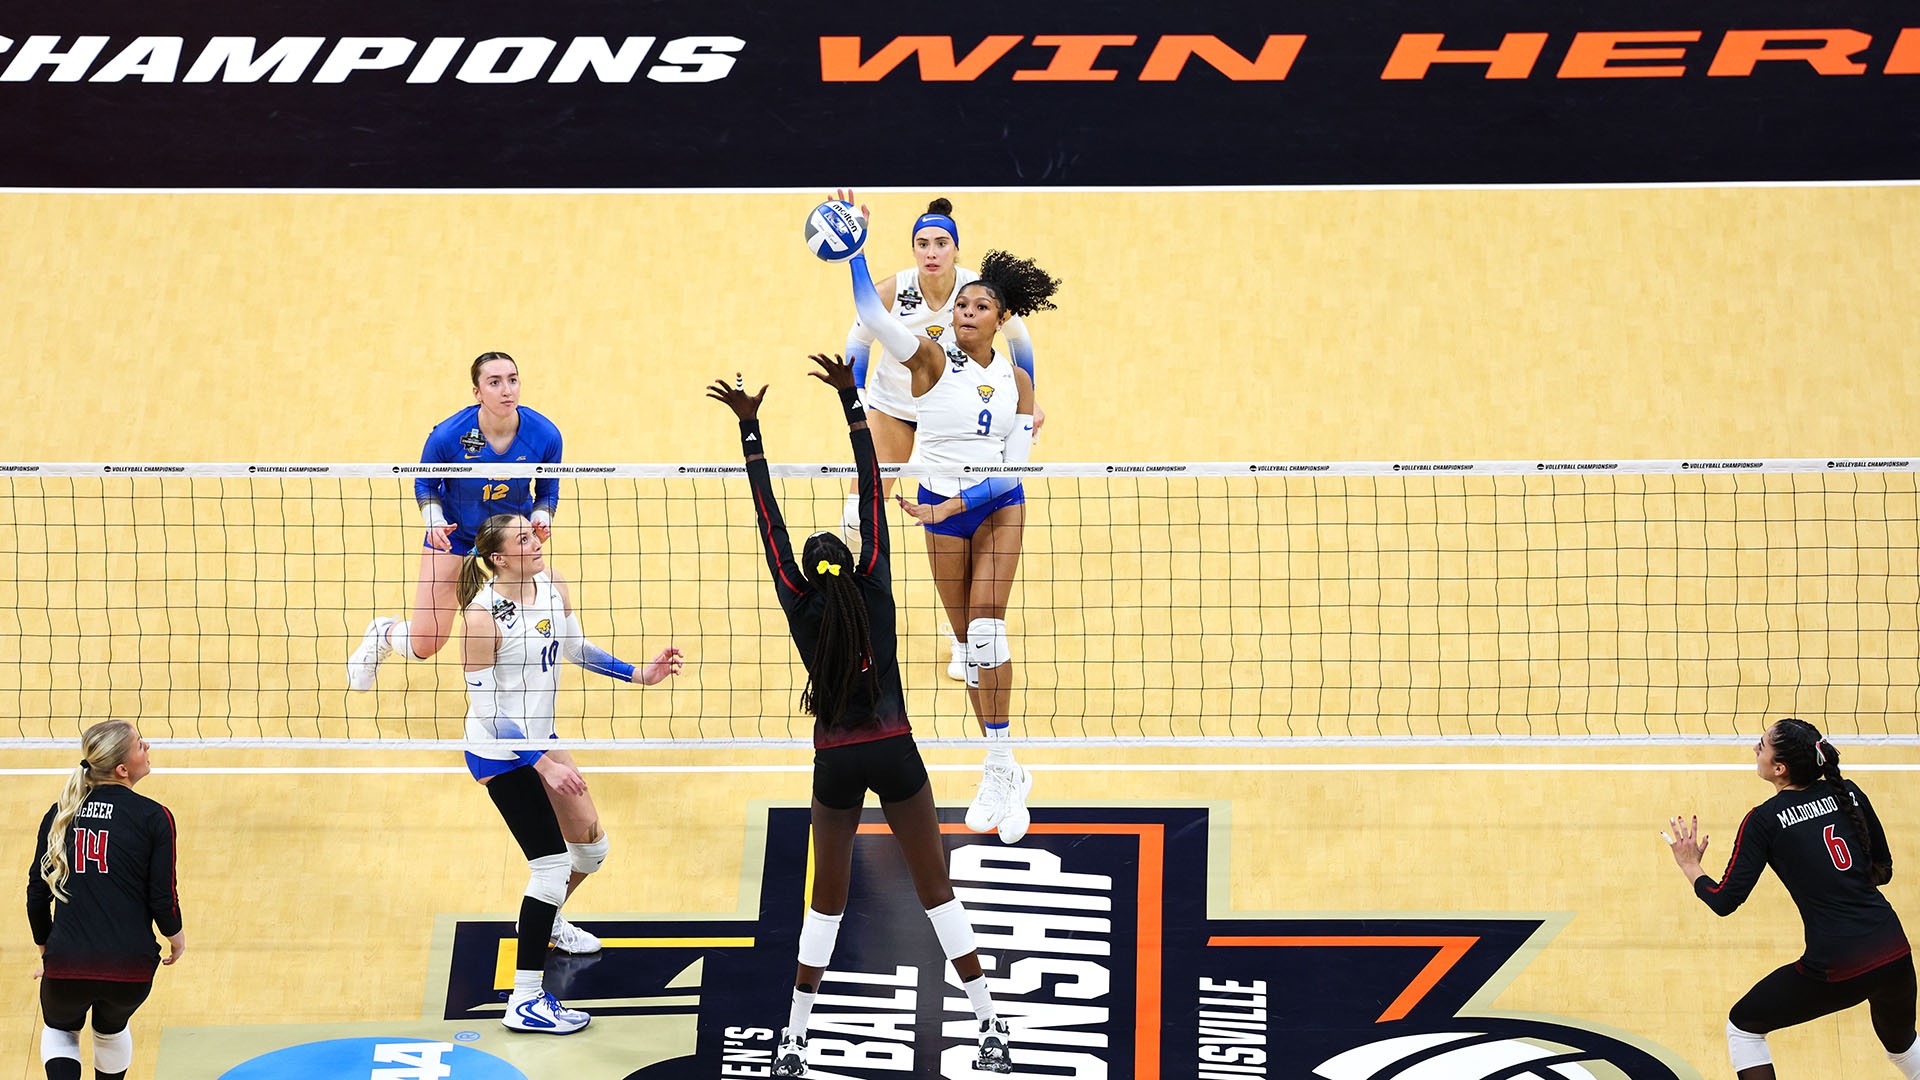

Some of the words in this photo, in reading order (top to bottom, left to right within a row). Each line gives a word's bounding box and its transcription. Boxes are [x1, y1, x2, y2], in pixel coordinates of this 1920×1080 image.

[0, 34, 747, 84] HAMPIONS
[819, 33, 1306, 82] WIN
[1380, 27, 1920, 80] HER
[977, 408, 993, 436] 9
[112, 465, 143, 473] VOLLEYBALL
[143, 465, 185, 473] CHAMPIONSHIP
[256, 465, 287, 473] VOLLEYBALL
[288, 465, 330, 473] CHAMPIONSHIP
[400, 465, 431, 473] VOLLEYBALL
[431, 465, 473, 473] CHAMPIONSHIP
[972, 465, 1002, 473] VOLLEYBALL
[1003, 465, 1044, 473] CHAMPIONSHIP
[1257, 464, 1288, 472] VOLLEYBALL
[1289, 464, 1330, 472] CHAMPIONSHIP
[1835, 461, 1866, 469] VOLLEYBALL
[1867, 461, 1910, 469] CHAMPIONSHIP
[482, 483, 510, 502] 12
[540, 640, 560, 673] 10
[1776, 795, 1838, 829] MALDONADO
[73, 827, 109, 873] 14
[1823, 823, 1853, 871] 6
[721, 1026, 774, 1080] EN'S
